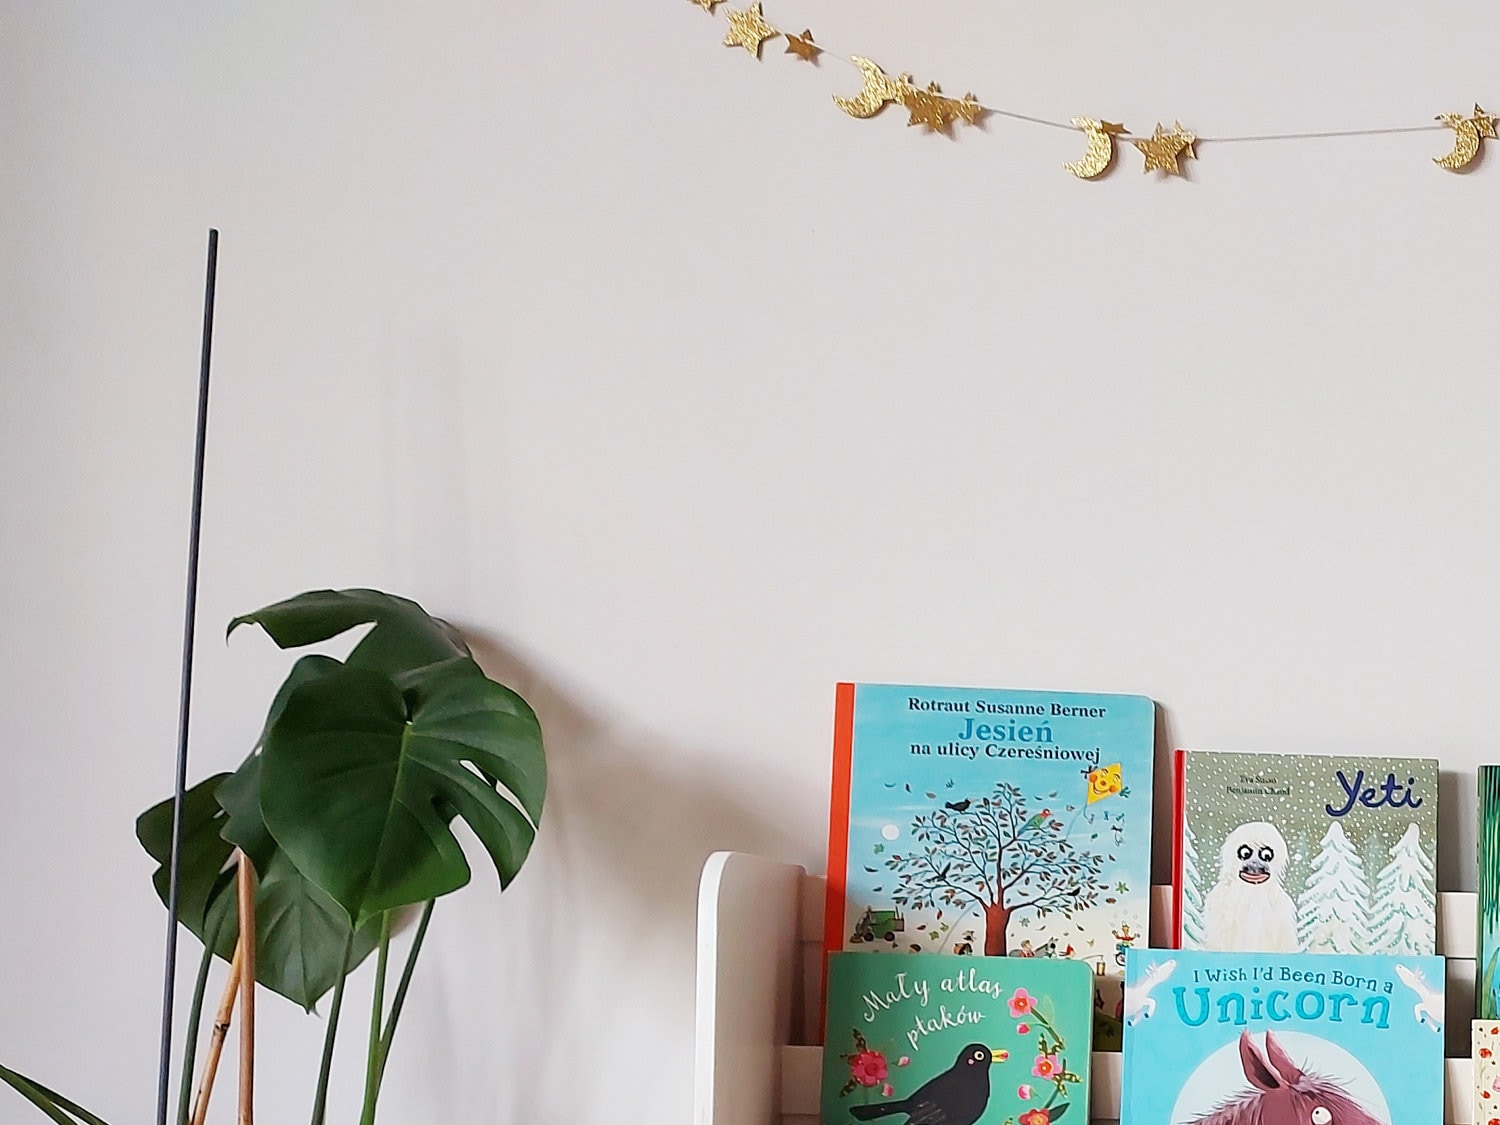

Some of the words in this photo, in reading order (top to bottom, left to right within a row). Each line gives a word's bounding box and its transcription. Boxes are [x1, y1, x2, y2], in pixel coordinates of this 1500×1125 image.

[908, 697, 970, 713] Rotraut
[975, 700, 1045, 715] Susanne
[1050, 703, 1106, 718] Berner
[958, 717, 1053, 743] Jesień
[910, 743, 931, 755] na
[937, 742, 979, 760] ulicy
[985, 743, 1100, 764] Czereśniowej
[1325, 769, 1423, 817] Yeti
[863, 972, 930, 1023] Mały
[941, 968, 1003, 999] atlas
[1192, 969, 1200, 983] I
[1204, 967, 1247, 983] Wish
[1252, 966, 1274, 982] I'd
[1280, 968, 1326, 986] Been
[1331, 970, 1377, 992] Born
[1383, 980, 1394, 994] a
[1172, 986, 1392, 1030] Unicorn
[907, 1005, 987, 1051] ptaków
